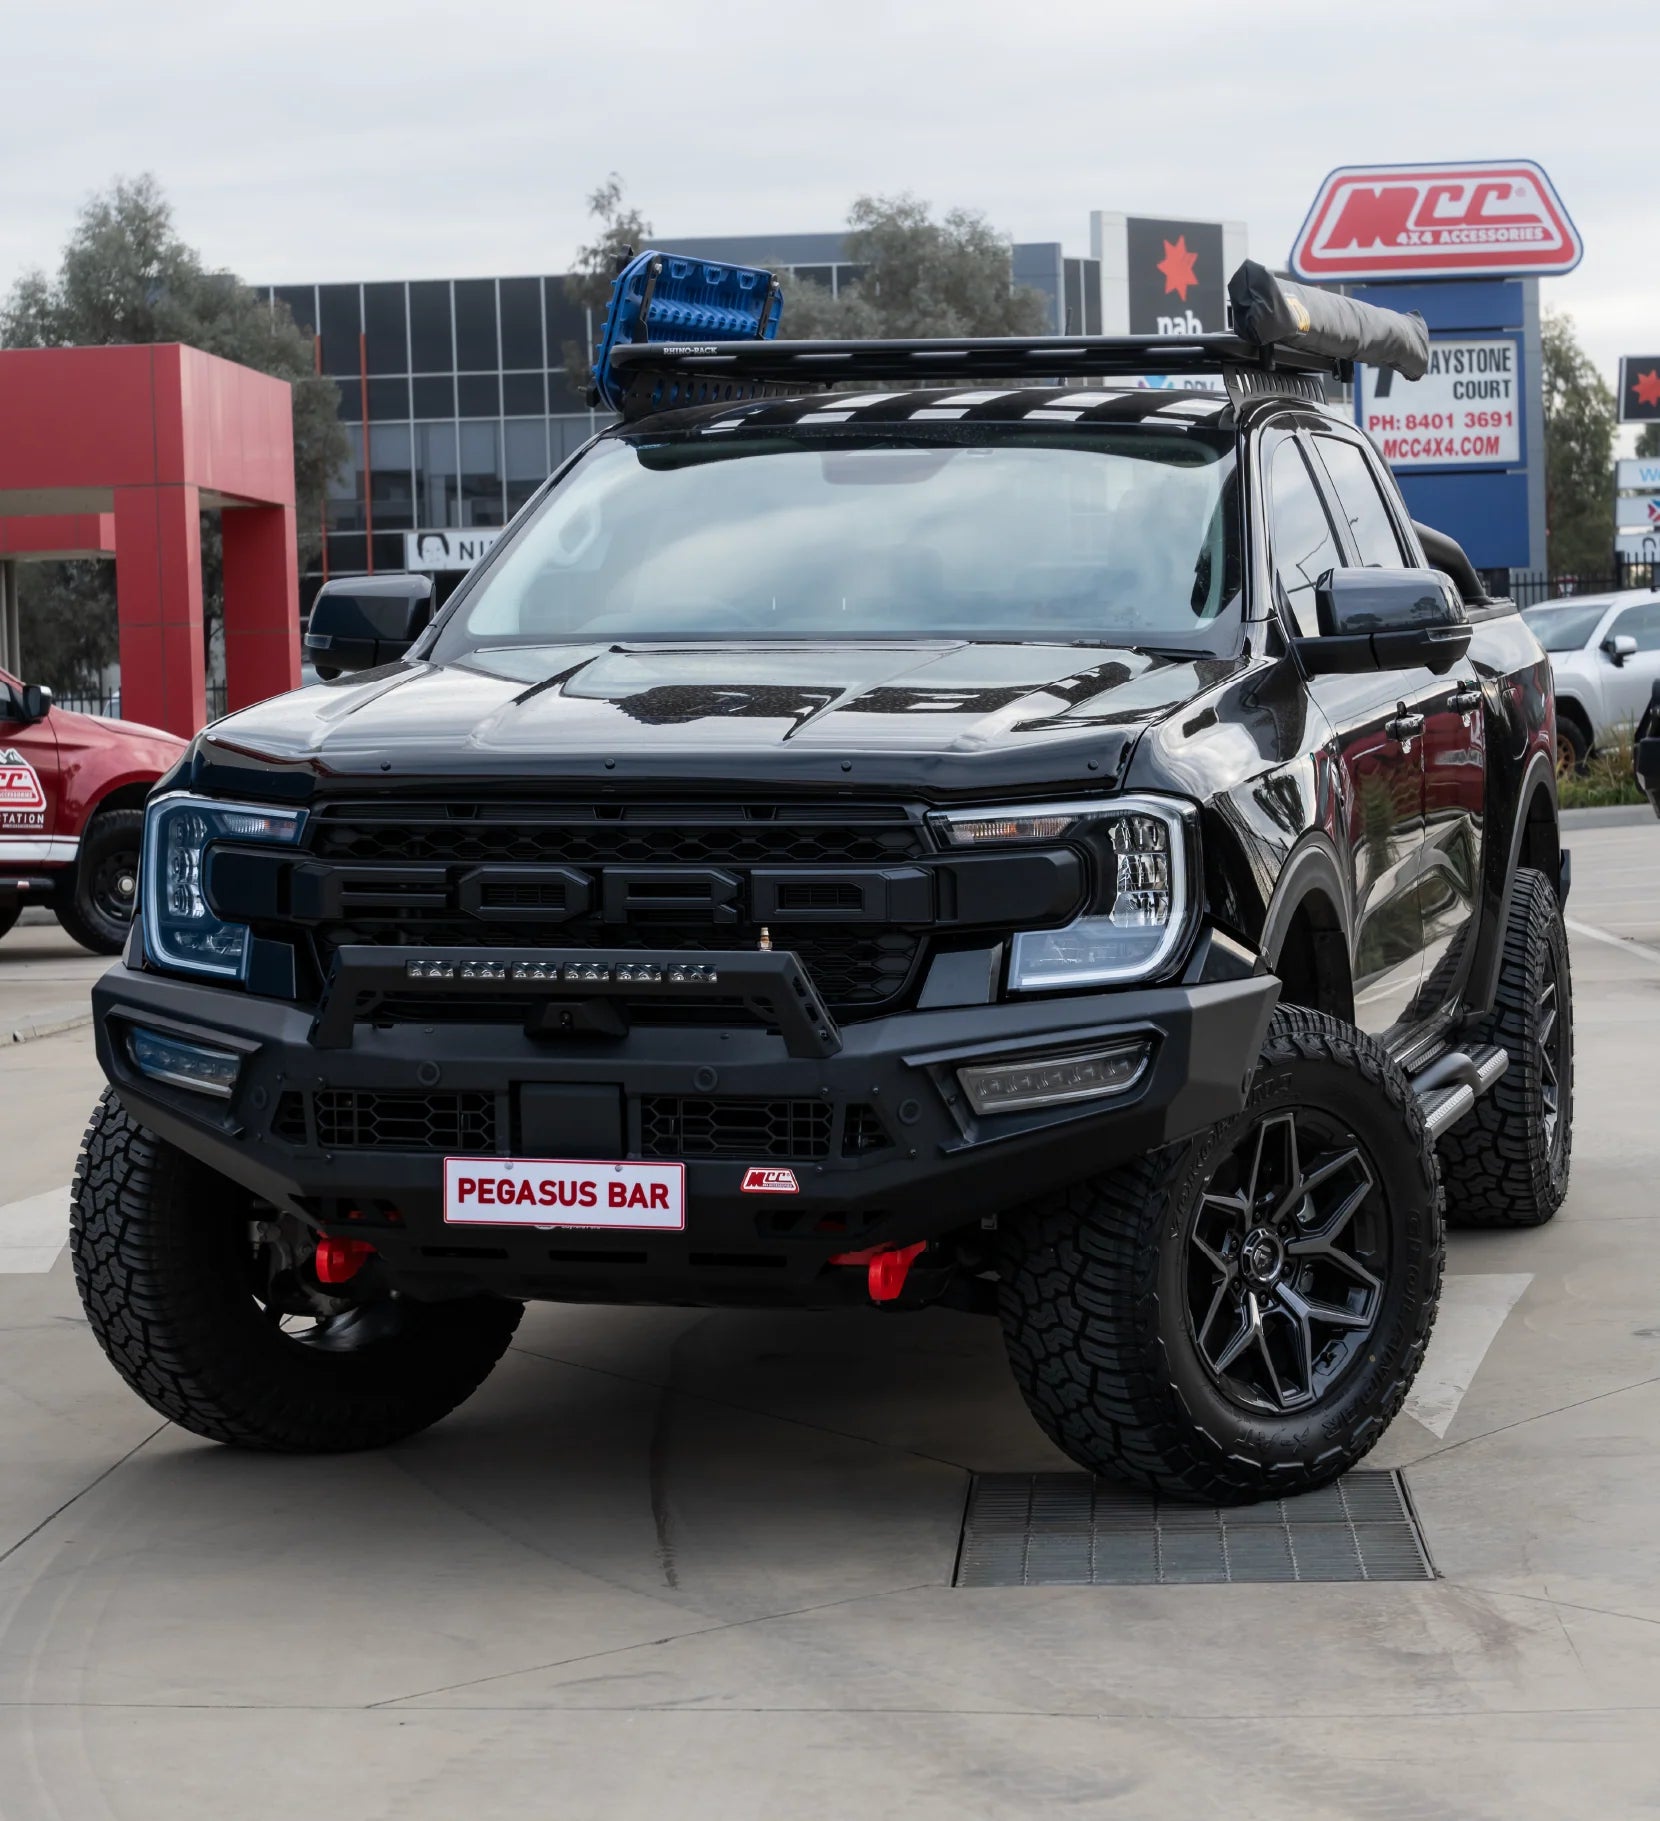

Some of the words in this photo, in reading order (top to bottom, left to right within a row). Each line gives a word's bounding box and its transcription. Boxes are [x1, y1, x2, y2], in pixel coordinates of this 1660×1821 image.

[1319, 183, 1545, 250] MCC
[1396, 231, 1434, 246] 4X4
[1439, 227, 1544, 245] ACCESSORIES
[1156, 310, 1204, 335] nab
[663, 346, 718, 355] RHINO-RACK
[1425, 347, 1512, 376] AYSTONE
[1453, 379, 1512, 400] COURT
[1369, 415, 1400, 431] PH:
[1405, 413, 1454, 431] 8401
[1464, 411, 1513, 428] 3691
[1383, 436, 1500, 459] MCC4X4.COM
[0, 812, 44, 824] TATION
[747, 1171, 793, 1187] MCC
[457, 1178, 598, 1208] PEGASUS
[608, 1182, 670, 1210] BAR
